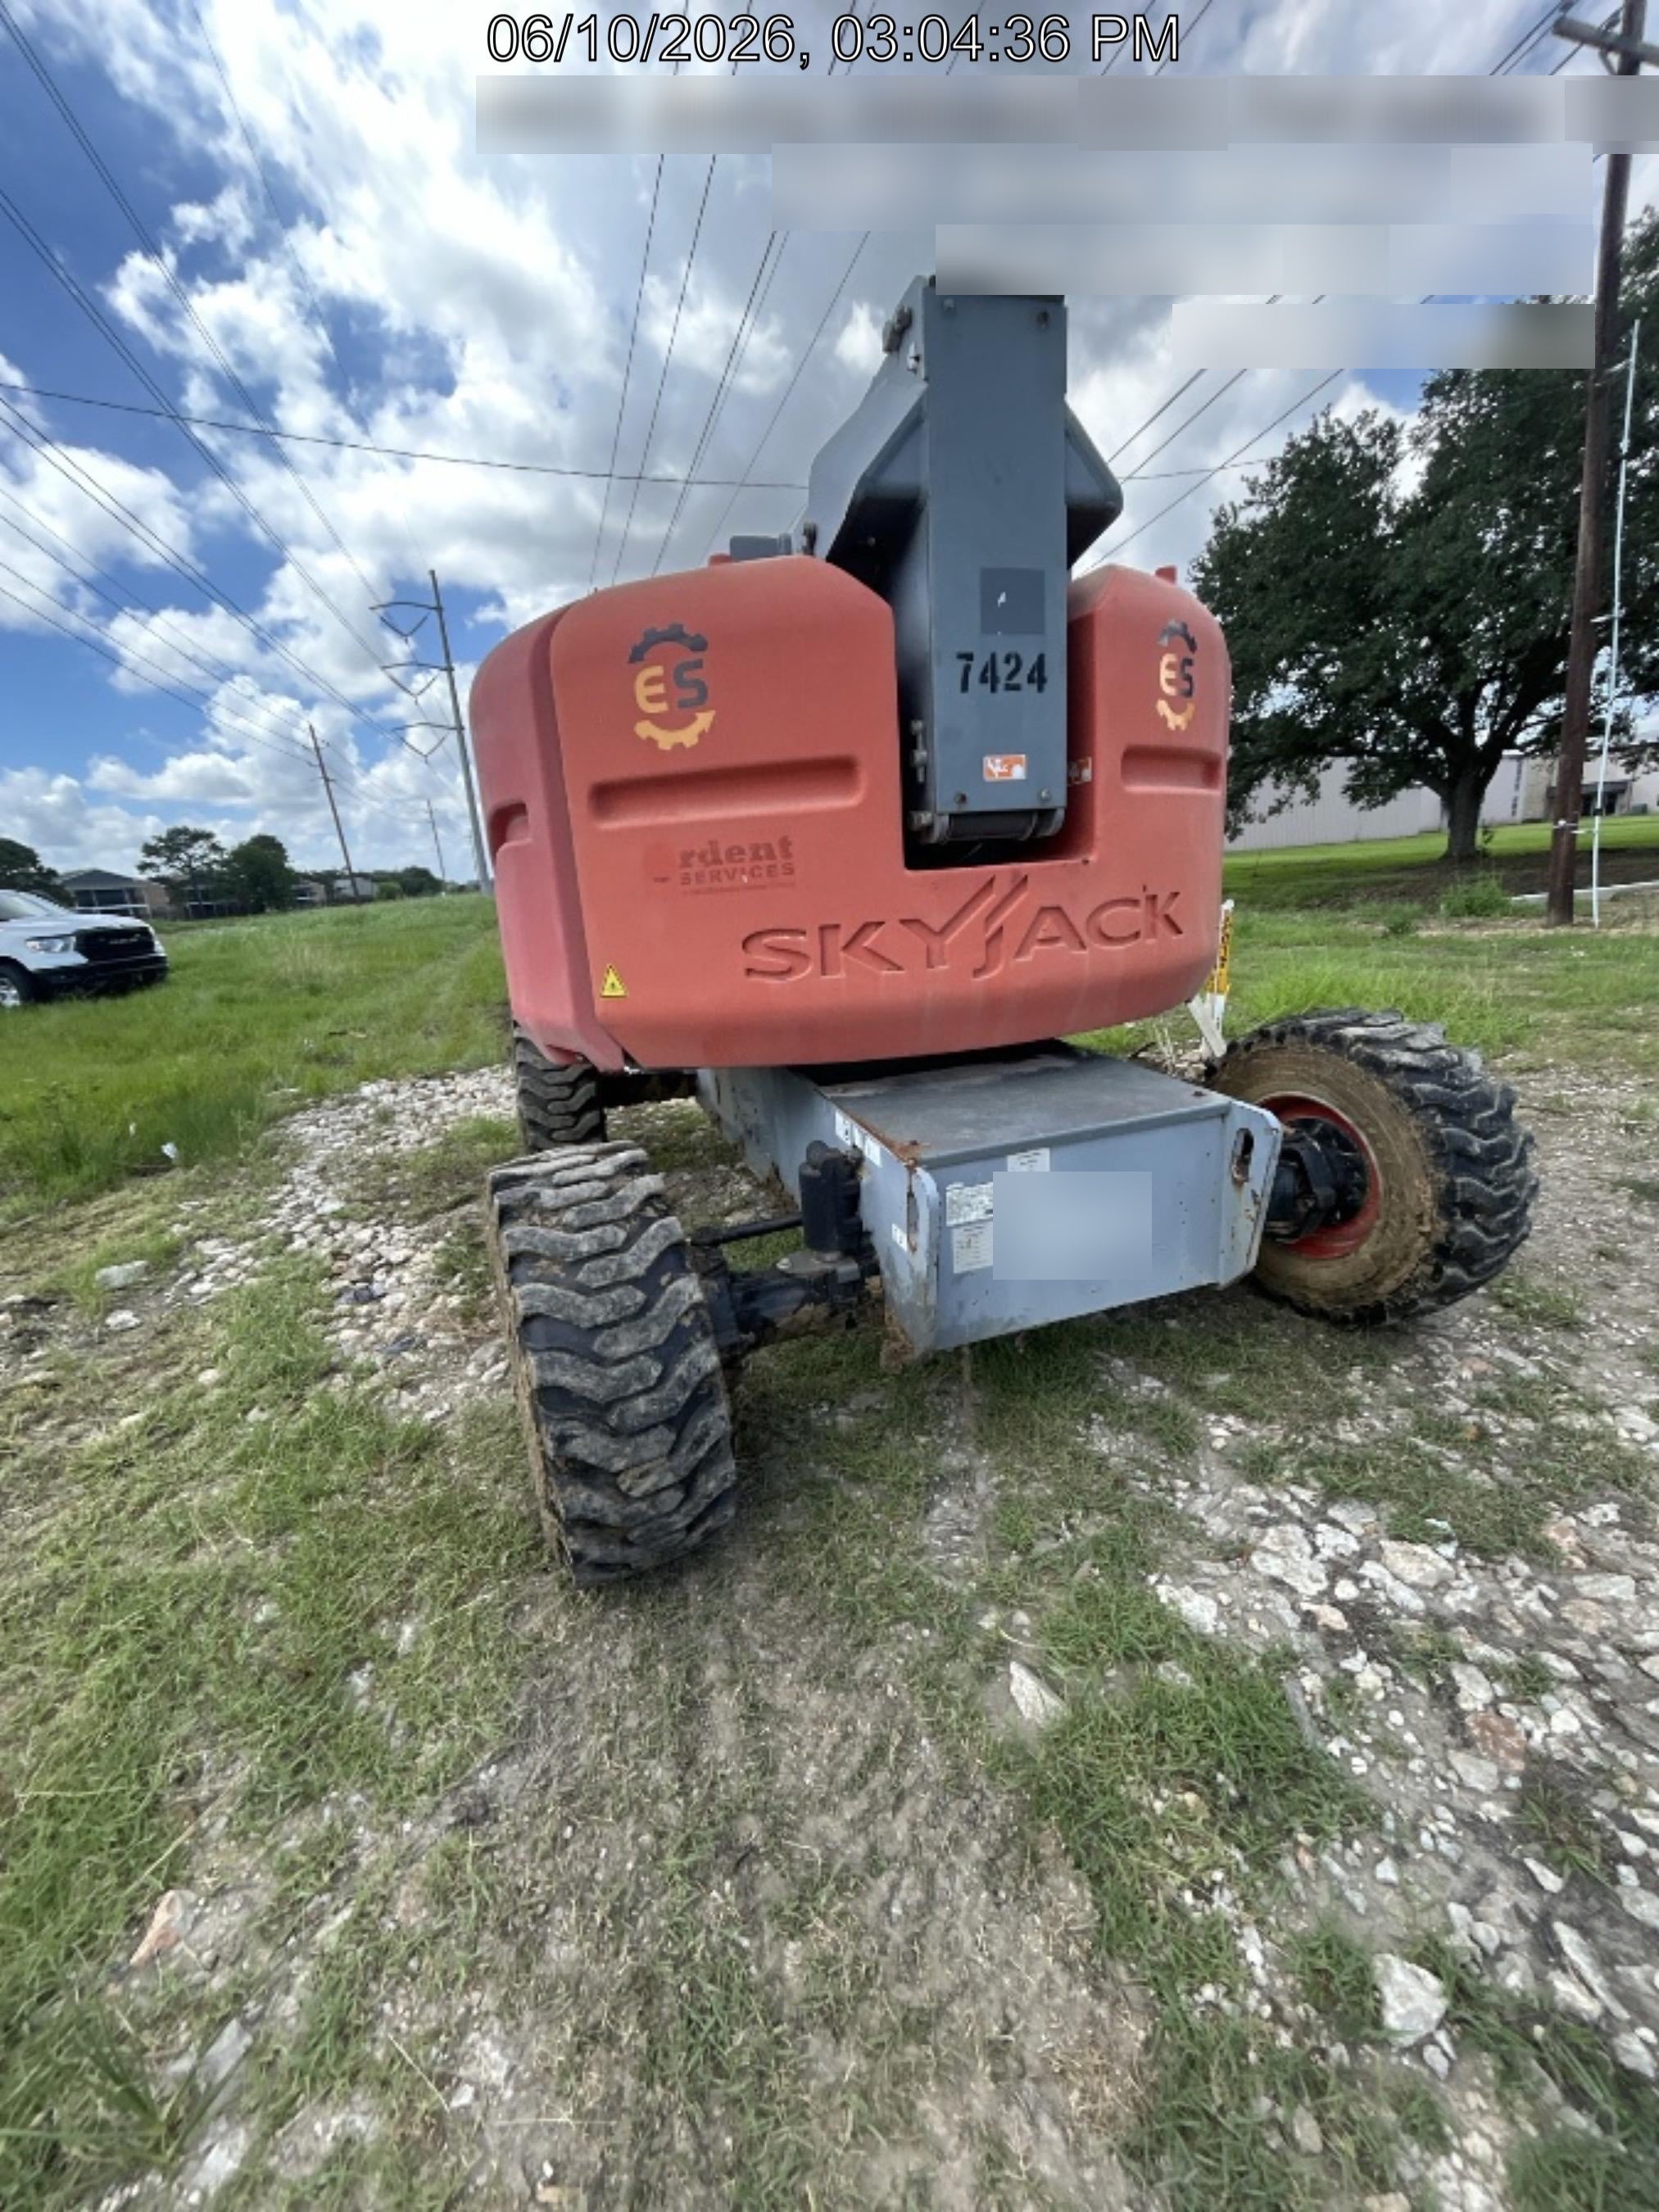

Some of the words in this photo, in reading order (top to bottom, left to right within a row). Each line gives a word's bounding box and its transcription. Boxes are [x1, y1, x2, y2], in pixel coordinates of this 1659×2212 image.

[634, 659, 709, 714] ES
[955, 651, 1048, 694] 7424
[1158, 653, 1194, 698] ES
[651, 836, 793, 869] rdent
[680, 863, 795, 886] SERVICES
[741, 874, 1184, 981] SKYJACK
